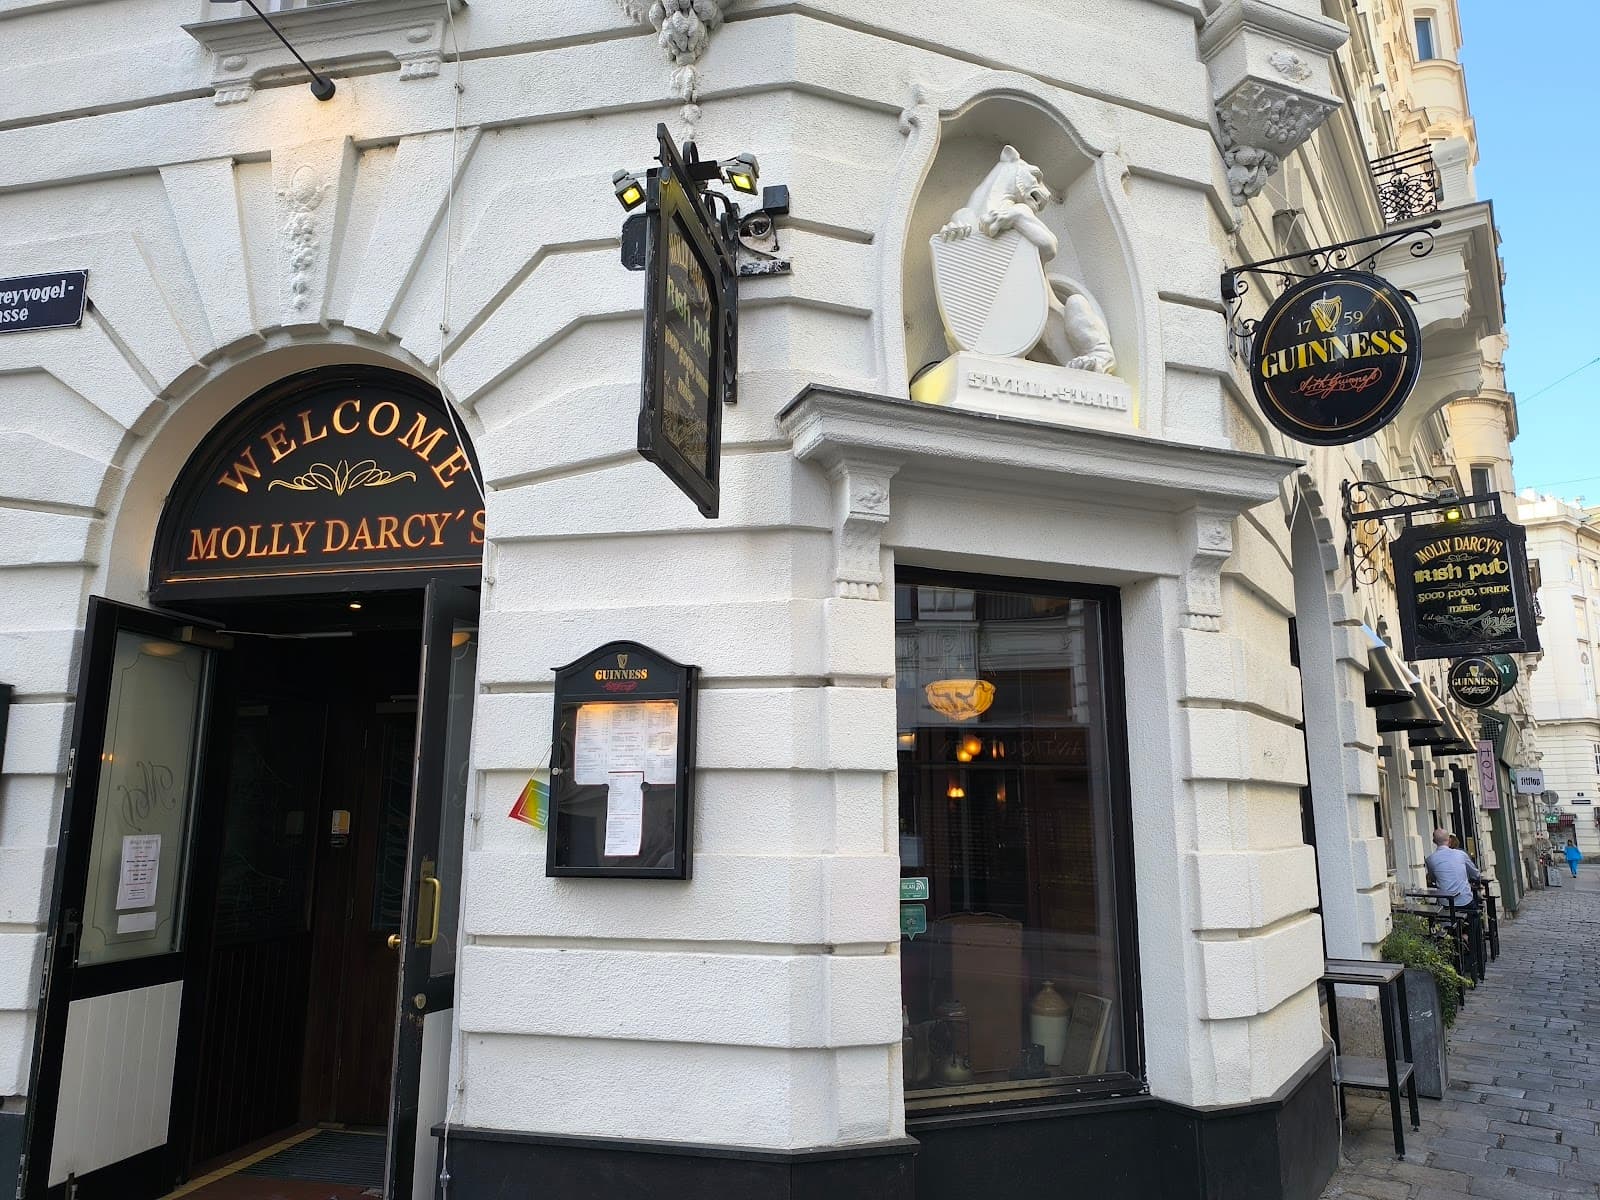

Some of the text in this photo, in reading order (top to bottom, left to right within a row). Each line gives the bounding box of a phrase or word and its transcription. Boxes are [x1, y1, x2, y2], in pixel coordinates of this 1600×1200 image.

[1296, 310, 1365, 336] 17 59
[1261, 328, 1409, 379] GUINNESS
[218, 399, 472, 494] WELCOME
[186, 520, 320, 561] MOLLY
[1414, 536, 1504, 564] MOLLY DARCY'S
[594, 668, 648, 681] GUINNESS
[1453, 677, 1499, 686] GUINNESS
